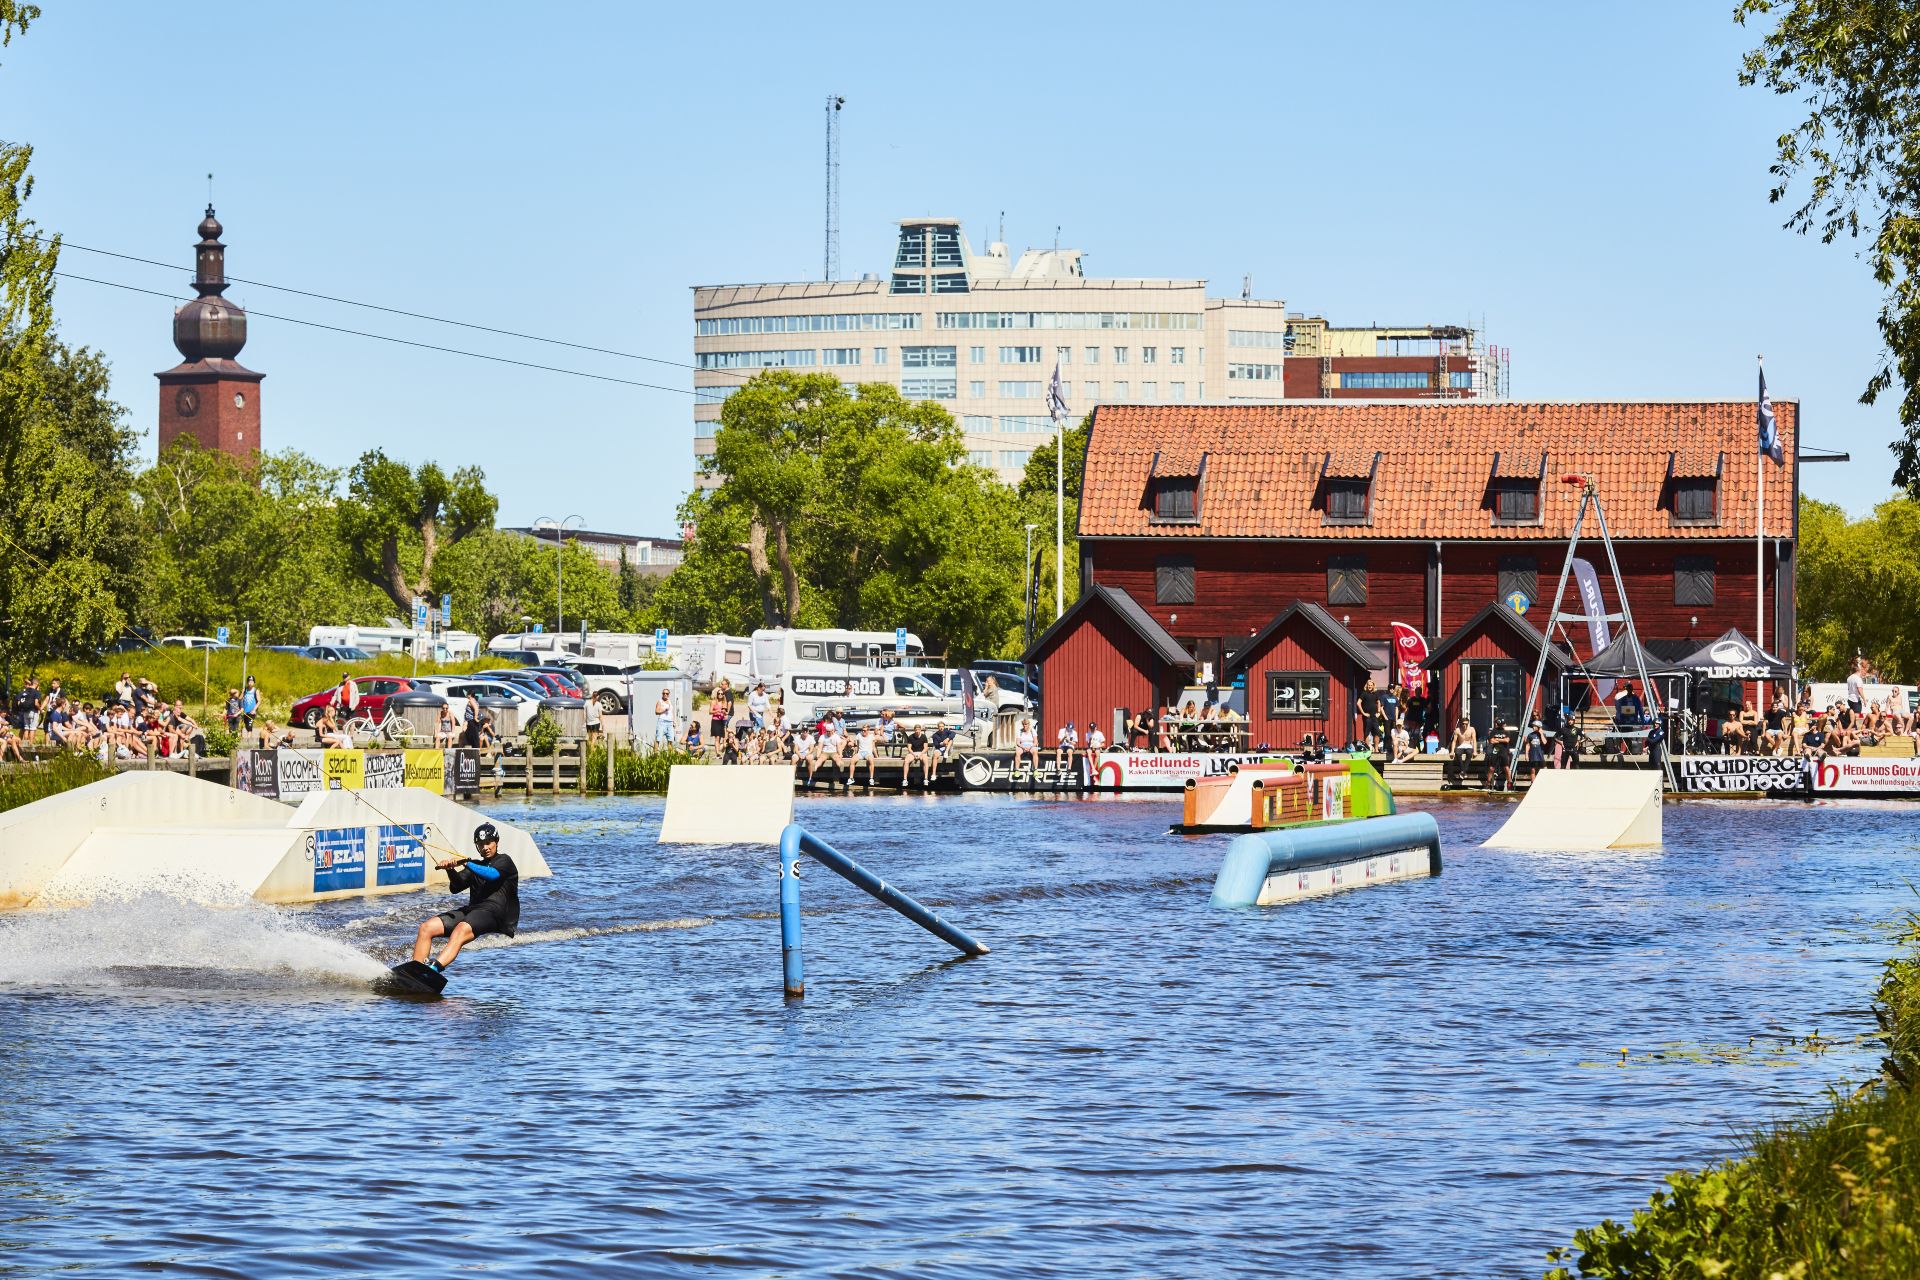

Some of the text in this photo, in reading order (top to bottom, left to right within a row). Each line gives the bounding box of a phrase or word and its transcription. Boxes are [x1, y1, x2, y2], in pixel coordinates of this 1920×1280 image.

[795, 677, 881, 695] BERGS RÖR
[329, 754, 357, 774] stadium
[459, 752, 476, 773] Room
[1128, 756, 1201, 768] Hedlunds
[1686, 757, 1803, 776] LIQUID FORCE
[1843, 764, 1890, 776] HEDLUNDS
[1892, 765, 1916, 777] GOLV
[405, 764, 442, 780] Mekonomen
[1686, 773, 1805, 792] LIQUID FORCE
